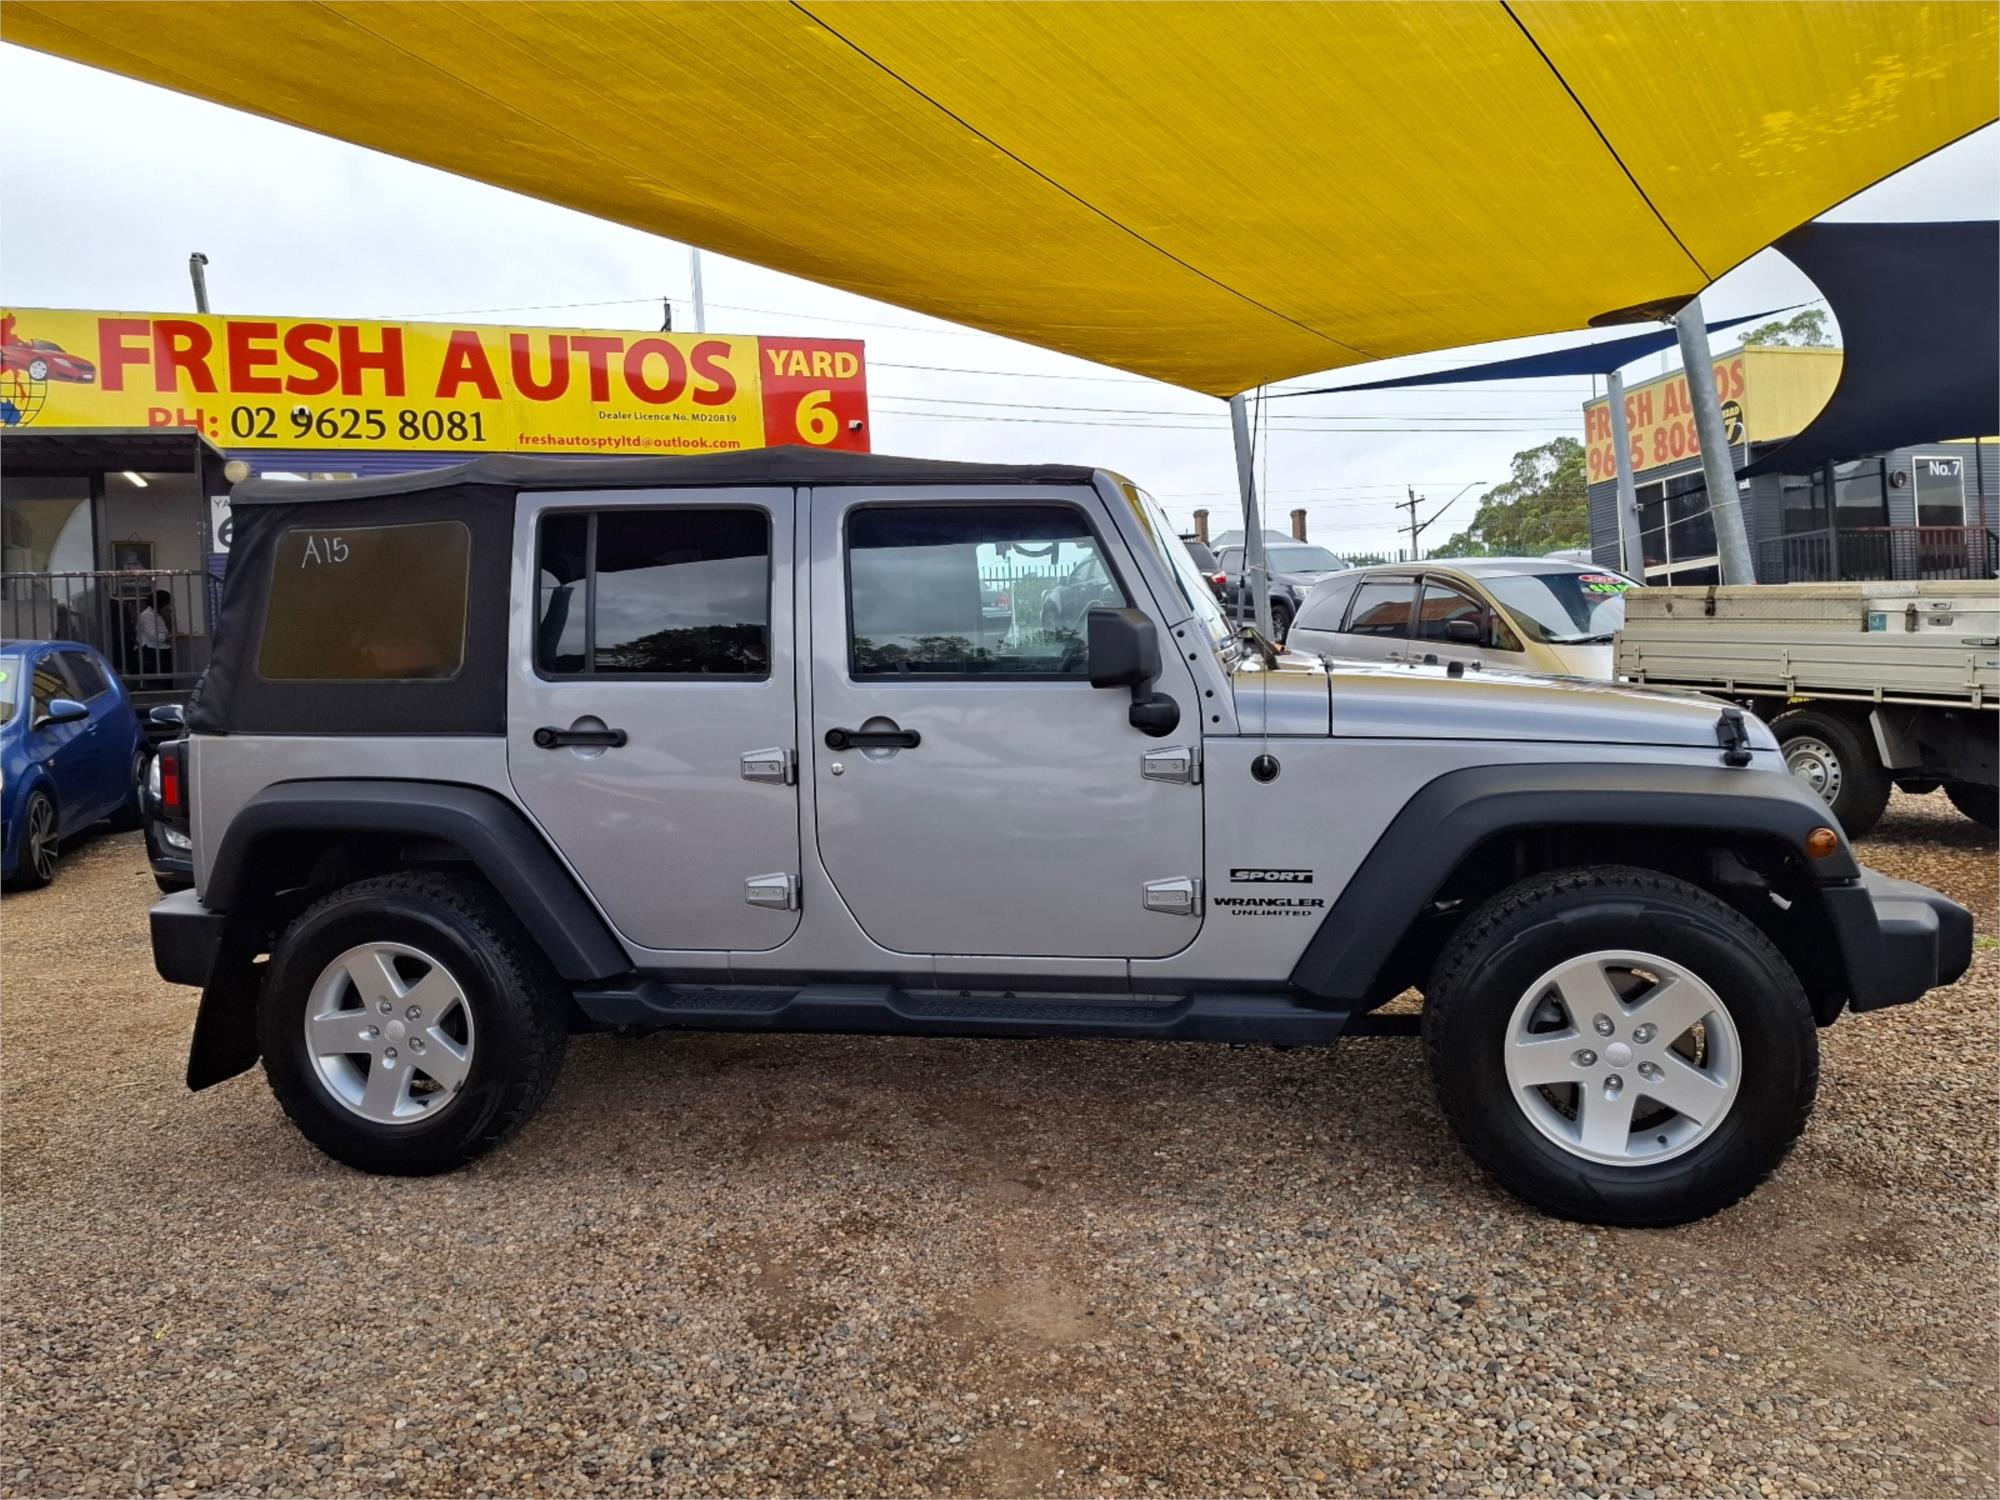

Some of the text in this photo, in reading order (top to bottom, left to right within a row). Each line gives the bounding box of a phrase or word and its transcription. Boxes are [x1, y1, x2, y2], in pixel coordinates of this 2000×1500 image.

[97, 318, 737, 406] FRESH AUTOS
[766, 348, 859, 379] YARD
[599, 410, 737, 422] Dealer Licence No. MD20819
[1585, 359, 1745, 444] FRSH AUOS
[148, 406, 487, 442] PH: 02 9625 8081
[796, 389, 839, 446] 6
[1725, 417, 1737, 440] 7
[518, 433, 741, 449] freshautosptyltd@outlook.com
[1589, 433, 1644, 481] 965
[302, 535, 349, 568] A15
[1234, 871, 1312, 881] SPORT
[1213, 898, 1325, 908] WRANGLER
[1231, 909, 1312, 917] UNLIMITED
